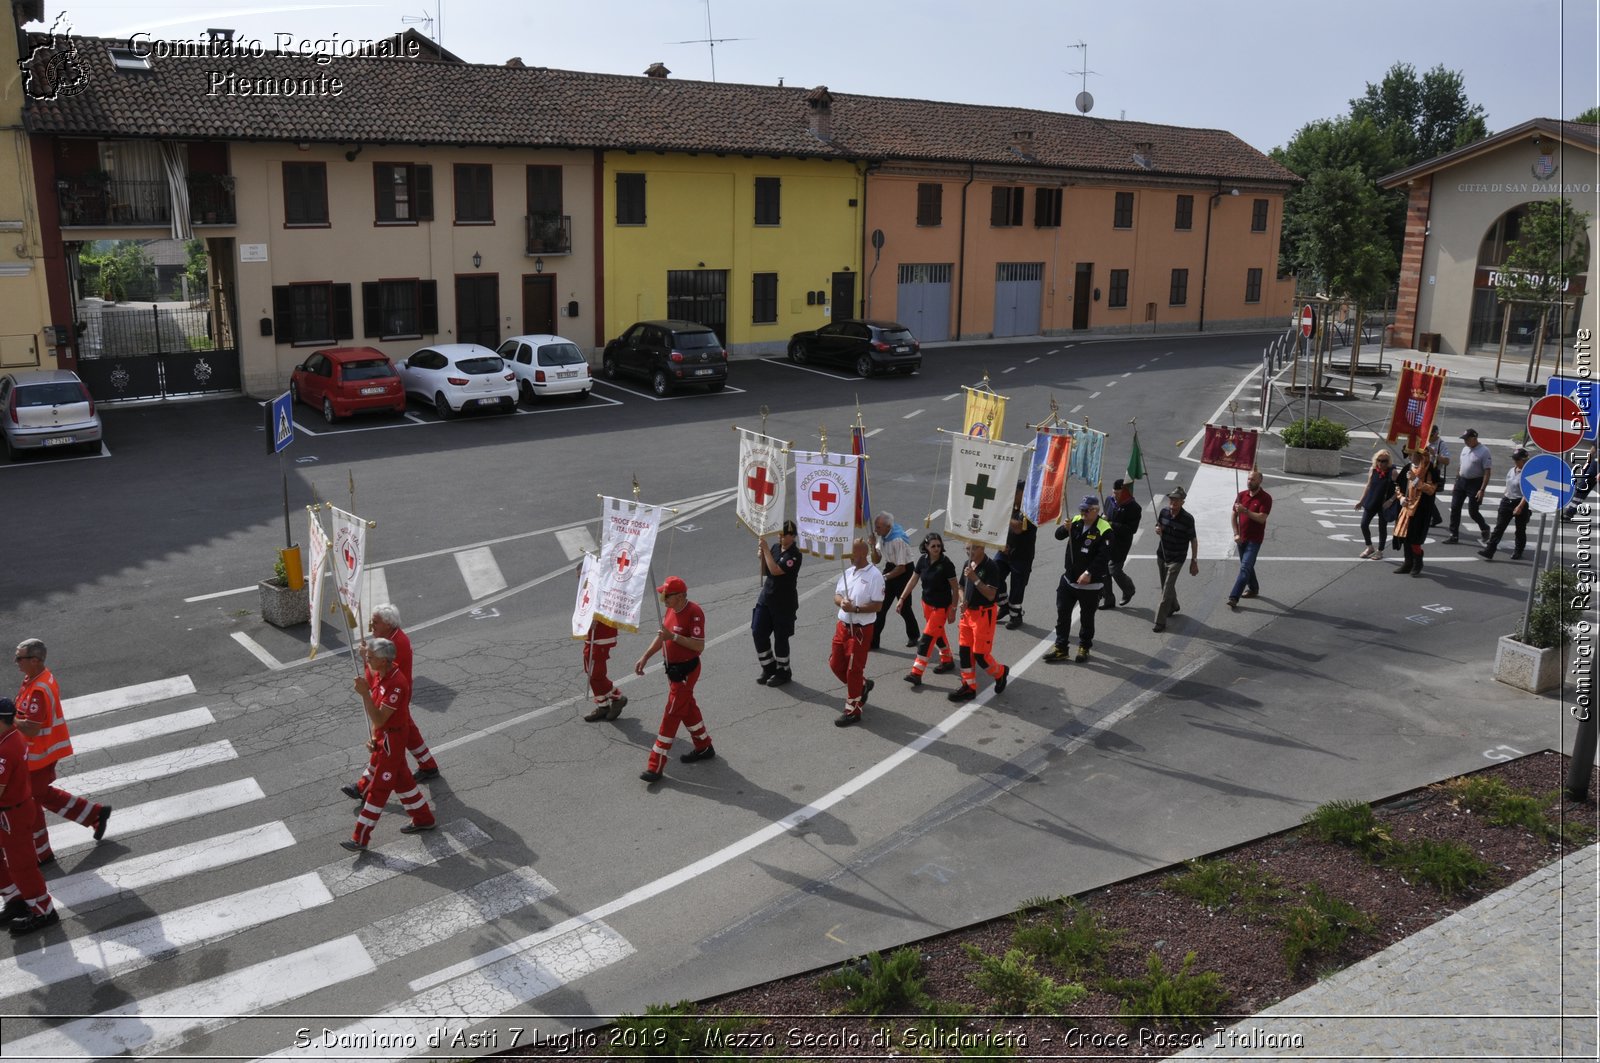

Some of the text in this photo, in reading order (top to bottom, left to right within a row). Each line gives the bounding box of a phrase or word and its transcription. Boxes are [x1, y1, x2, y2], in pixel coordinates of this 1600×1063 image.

[1491, 183, 1502, 193] DI
[1505, 183, 1528, 193] SAN
[1531, 183, 1591, 193] DAMIANO
[960, 448, 1015, 462] CROCE VERDE
[800, 469, 850, 496] CROCE ROSSA ITALIANA
[800, 516, 849, 527] COMITATO LOCALE
